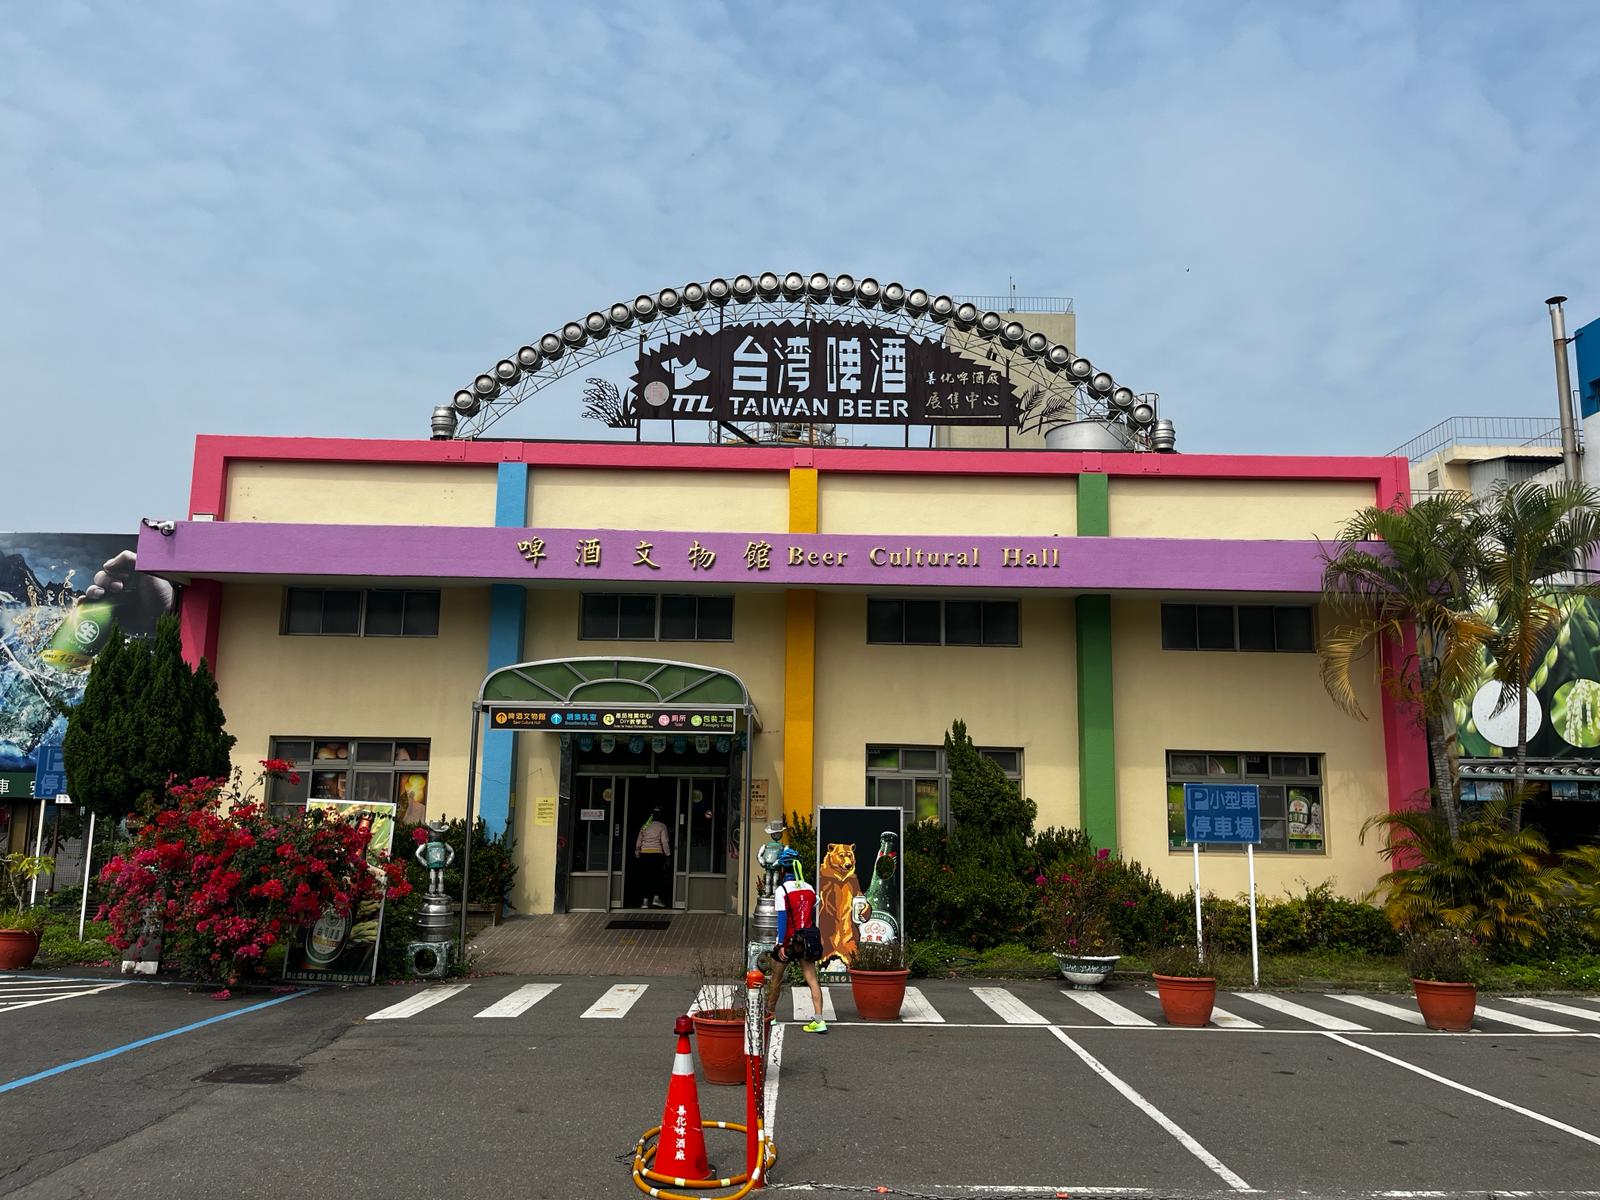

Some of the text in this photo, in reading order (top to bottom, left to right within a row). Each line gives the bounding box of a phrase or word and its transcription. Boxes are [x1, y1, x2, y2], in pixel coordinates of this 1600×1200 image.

[672, 394, 714, 413] TTL
[729, 397, 909, 418] TAIWAN BEER
[926, 391, 1000, 410] 展售中心
[517, 536, 1060, 569] 啤酒文物館 Beer Cultural Hall
[1209, 790, 1257, 810] 小型車
[1192, 815, 1255, 839] 停車場
[674, 1104, 687, 1161] 善化啤酒廠
